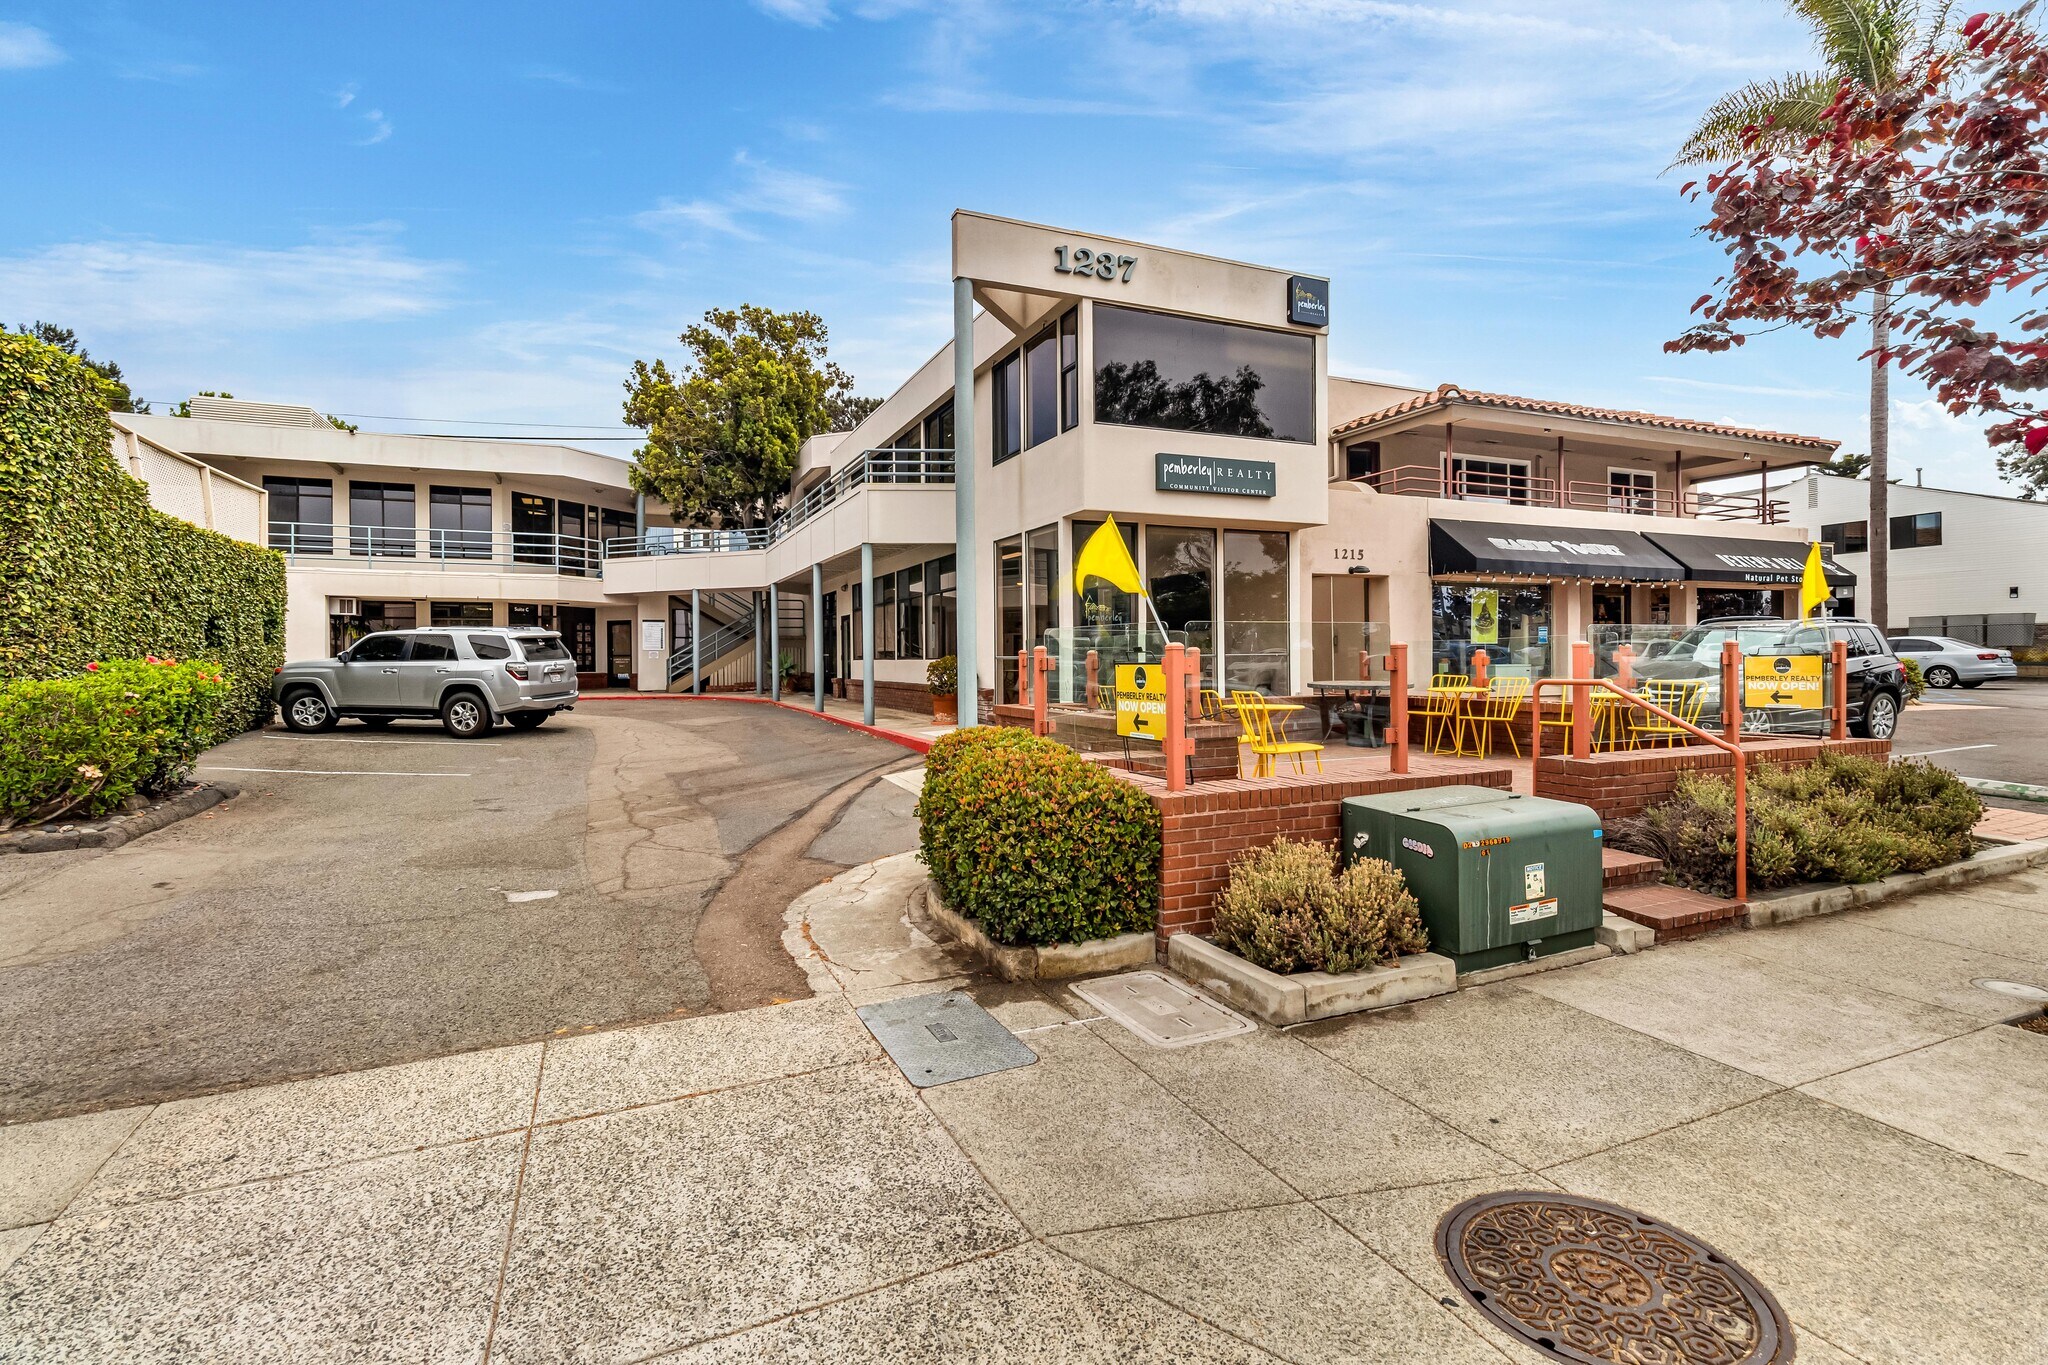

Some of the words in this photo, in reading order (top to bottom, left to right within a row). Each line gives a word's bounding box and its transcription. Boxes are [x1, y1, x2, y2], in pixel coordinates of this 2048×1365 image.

[1054, 245, 1138, 284] 1237
[1298, 298, 1326, 317] pemberley
[1163, 458, 1212, 485] pemberley
[1217, 467, 1272, 480] REALTY
[1169, 483, 1210, 491] COMMUNITY
[1213, 486, 1239, 494] VISITOR
[1334, 548, 1364, 561] 1215
[1745, 573, 1773, 582] Natural
[1776, 574, 1788, 583] Pet
[1791, 575, 1803, 583] Sto
[1748, 681, 1779, 690] NOW
[1781, 682, 1820, 691] OPEN!
[1116, 691, 1145, 701] PEMBERLEY
[1146, 692, 1167, 702] REALTY
[1118, 700, 1139, 712] NOW
[1140, 702, 1167, 714] OPEN!
